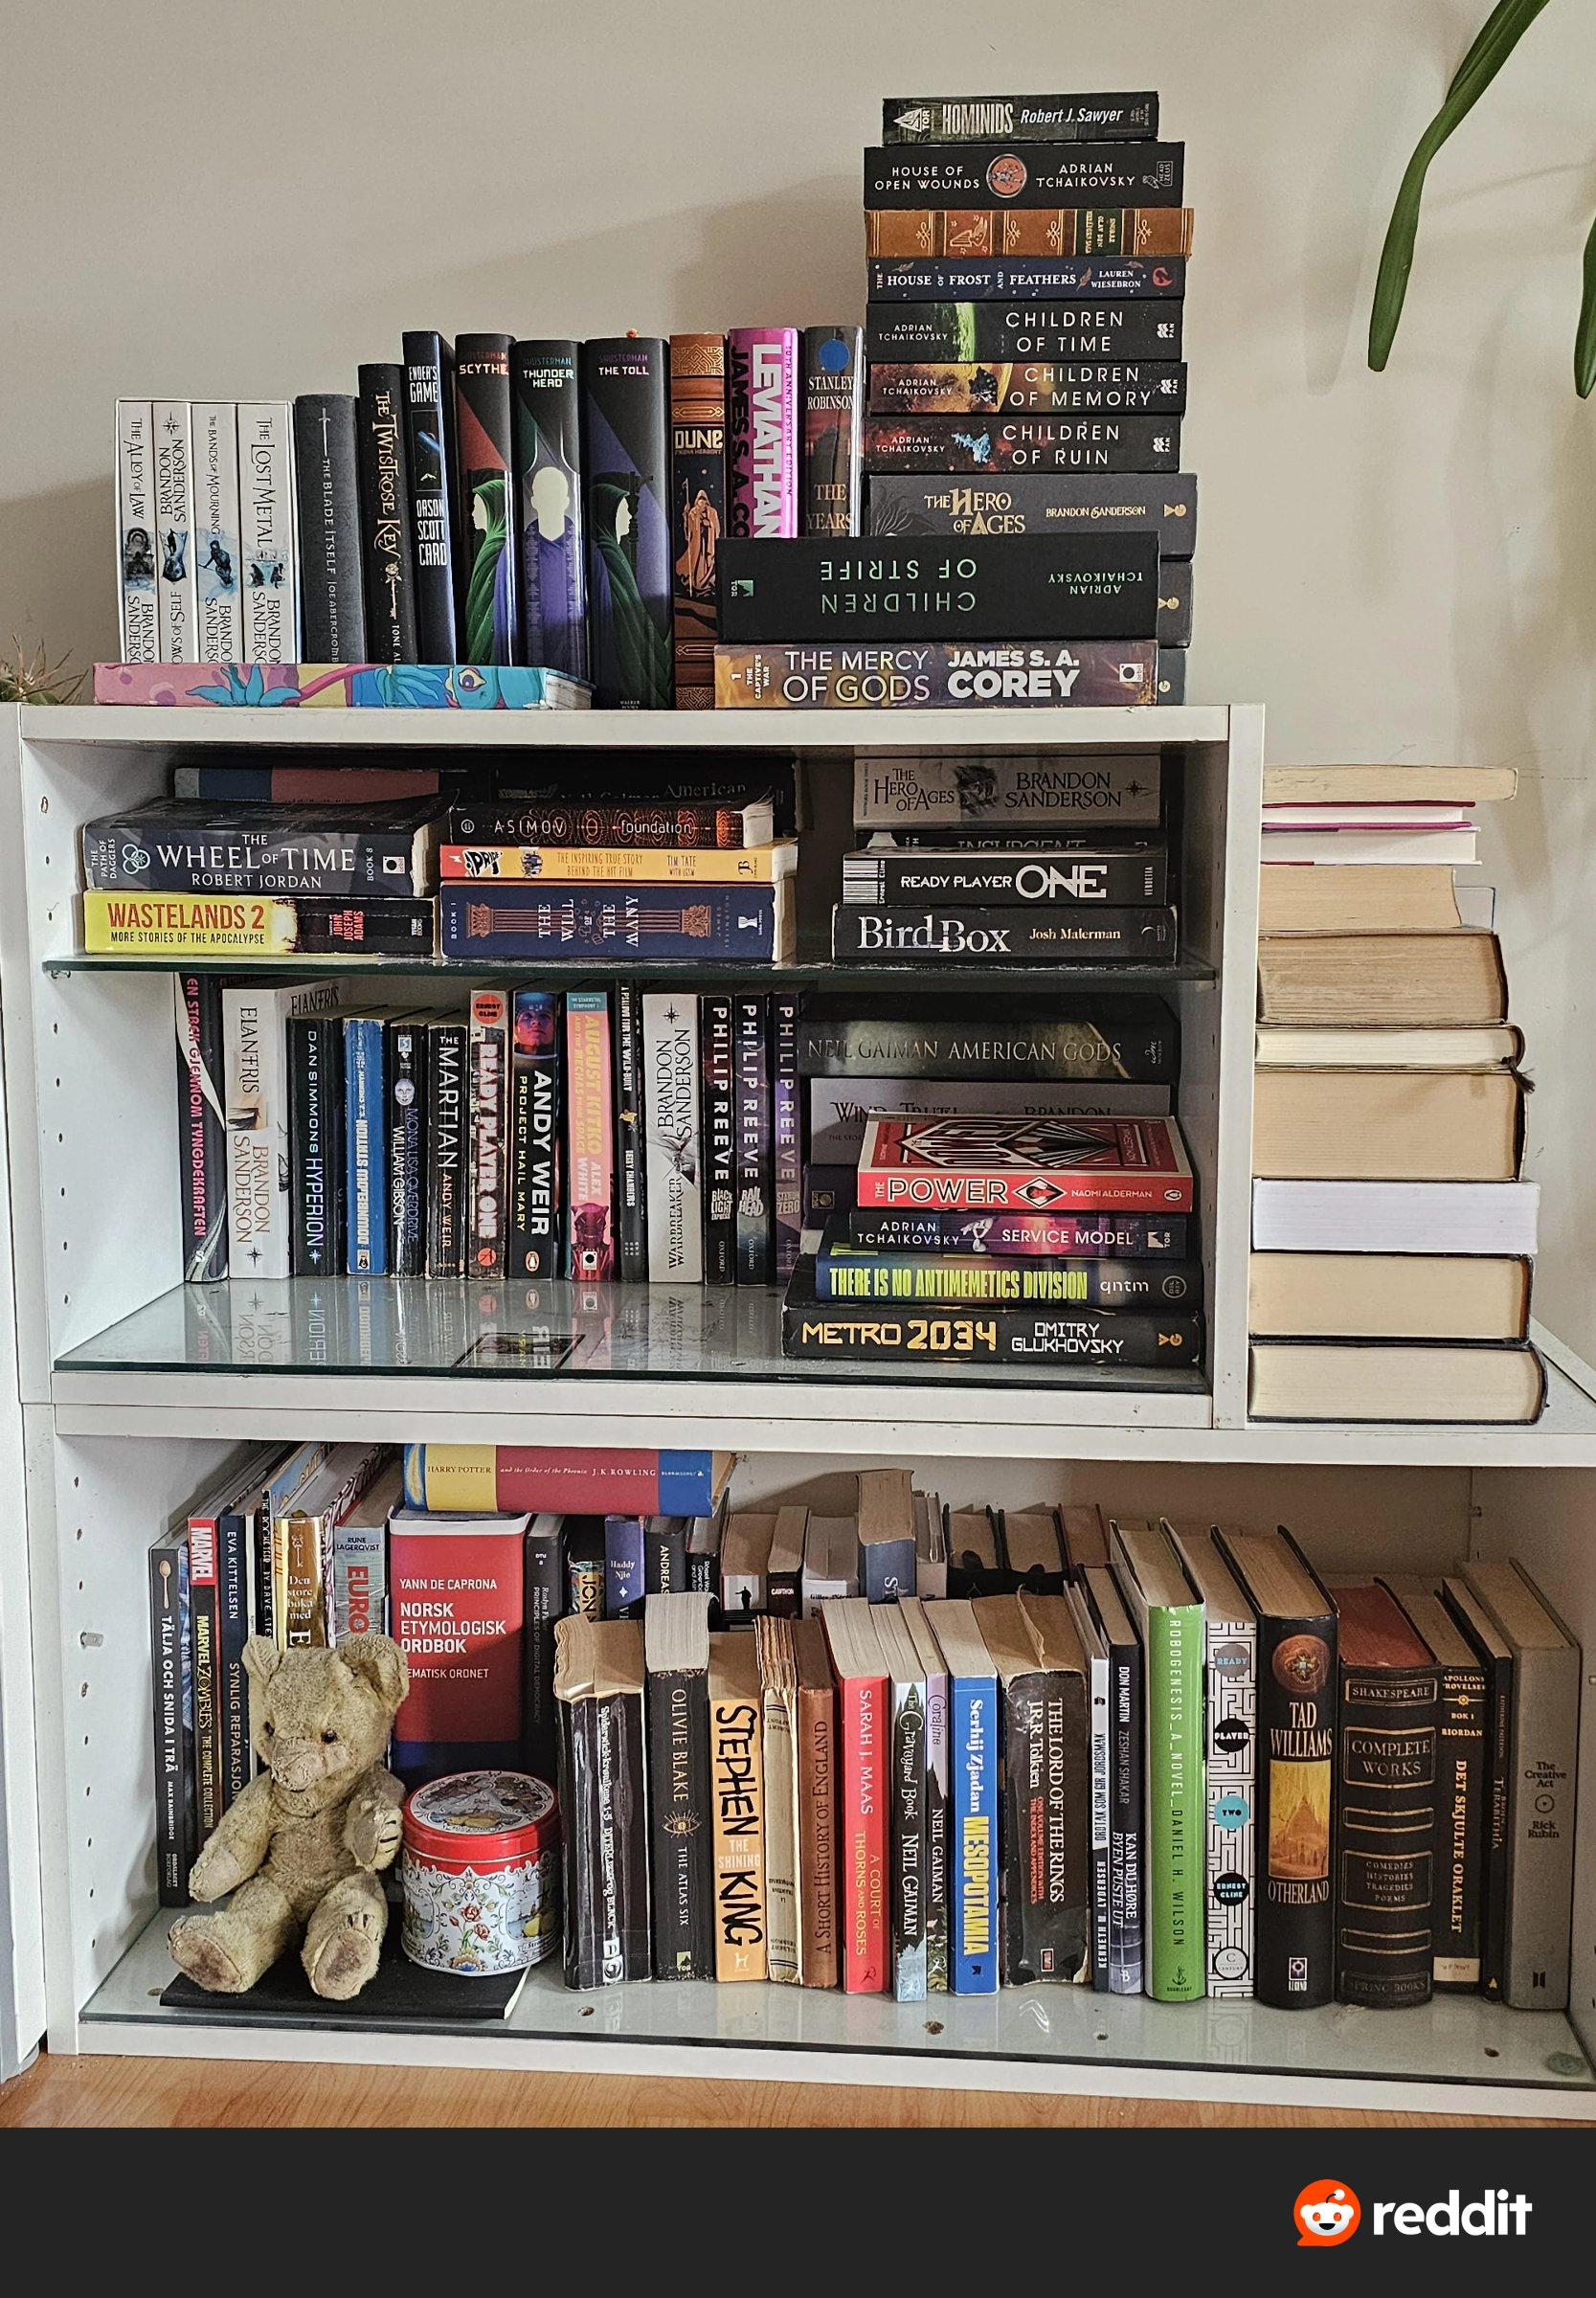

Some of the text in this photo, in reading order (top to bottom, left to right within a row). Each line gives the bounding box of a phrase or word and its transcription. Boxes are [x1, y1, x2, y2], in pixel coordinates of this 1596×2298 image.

[942, 103, 1014, 135] HOMINIDS
[1021, 108, 1074, 124] Robert J.
[892, 166, 963, 177] HOUSE OF
[1059, 163, 1113, 174] ADRIAN
[874, 178, 979, 191] OPEN WOUNDS
[1036, 175, 1135, 188] TCHAIKOVSKY
[888, 275, 932, 286] HOUSE
[949, 275, 991, 285] FROST
[1009, 274, 1076, 285] FEATHERS
[1005, 311, 1123, 327] CHILDREN
[1017, 336, 1112, 352] OF TIME
[409, 367, 438, 382] ENDER'S
[459, 363, 508, 375] SCYTHE
[523, 368, 574, 380] THUNDER
[598, 366, 649, 375] THE TOLL
[1024, 368, 1139, 382] CHILDREN
[532, 378, 563, 388] HEAD
[410, 382, 438, 403] GAME
[1010, 391, 1151, 406] OF MEMORY
[807, 395, 853, 411] ROBINSON
[675, 428, 724, 449] DUNE
[1003, 425, 1119, 440] CHILDREN
[1012, 449, 1109, 464] OF RUIN
[159, 447, 172, 515] BRANDON
[173, 439, 187, 523] SANDERSON
[814, 484, 846, 501] THE
[416, 499, 444, 517] ORSON
[806, 512, 852, 529] YEARS
[417, 521, 445, 540] SCOTT
[419, 546, 447, 566] CARD
[820, 559, 977, 580] OF STRIFE
[821, 592, 976, 613] CHILDREN
[785, 651, 929, 670] THE MERCY
[948, 649, 1079, 667] JAMES S. A.
[783, 675, 931, 701] OF GODS
[947, 670, 1080, 698] COREY
[1016, 772, 1111, 790] BRANDON
[1005, 791, 1122, 810] SANDERSON
[495, 820, 565, 834] ASIMOV
[621, 819, 692, 835] foundation
[241, 834, 267, 845] THE
[156, 845, 355, 871] WHEEL OF TIME
[191, 873, 322, 890] ROBERT JORDAN
[901, 865, 1107, 898] READY PLAYER ONE
[107, 903, 265, 929] WASTELANDS 2
[111, 932, 264, 944] MORE STORIES OF THE APOCALYPSE
[1029, 928, 1120, 941] Josh Malerman
[948, 1040, 1122, 1062] AMERICAN GODS
[712, 1006, 730, 1182] PHILIP REEVE
[438, 1047, 459, 1168] MARTIAN
[305, 1030, 324, 1247] DAN SIMMONS HYPERION
[530, 1070, 551, 1236] ANDY WEIR
[235, 1135, 252, 1243] SANDERSON
[252, 1145, 270, 1233] BRANDON
[888, 1178, 1008, 1204] POWER
[880, 1222, 936, 1232] ADRIAN
[858, 1233, 959, 1245] TCHAIKOVSKY
[1001, 1228, 1134, 1245] SERVICE MODEL
[830, 1268, 1088, 1300] THERE IS NO ANTIMEMETICS DIVISION
[1100, 1278, 1149, 1294] qntm
[802, 1319, 997, 1351] METRO 2034
[1011, 1339, 1124, 1355] GLUKHOVSKY
[191, 1526, 213, 1580] MARVEL
[400, 1579, 497, 1590] YANN DE CAPRONA
[400, 1603, 454, 1617] NORSK
[400, 1620, 506, 1635] ETYMOLOGISK
[161, 1616, 173, 1657] TÄLJA
[401, 1638, 467, 1654] ORDBOK
[1217, 1657, 1248, 1666] READY
[163, 1659, 173, 1683] OCH
[1352, 1686, 1429, 1699] SHAKESPEARE
[163, 1685, 174, 1735] SNIDA
[1289, 1701, 1316, 1728] TAD
[1442, 1728, 1483, 1737] RIORDAN
[671, 1688, 688, 1802] OLIVIE BLAKE
[860, 1689, 873, 1814] SARAH J. MAAS
[1270, 1728, 1333, 1758] WILLIAMS
[1351, 1739, 1430, 1755] COMPLETE
[165, 1747, 177, 1772] TRÄ
[962, 1699, 984, 1813] Serhij Zjadan
[715, 1705, 759, 1836] STEPHEN
[1362, 1761, 1422, 1777] WORKS
[1535, 1762, 1556, 1770] The
[1524, 1770, 1566, 1780] Creative
[1536, 1779, 1554, 1789] Act
[1527, 1829, 1560, 1838] Rubin
[1532, 1820, 1556, 1830] Rick
[729, 1839, 750, 1853] THE
[813, 1721, 831, 1954] A SHORT HISTORY OF ENGLAND
[1450, 1760, 1468, 1933] DET SKJULTE ORAKLET
[718, 1856, 761, 1869] SHINING
[677, 1847, 688, 1926] THE ATLAS SIX
[902, 1834, 919, 1936] NEIL GAIMAN
[963, 1816, 989, 1955] MESOPOTAMIA
[1269, 1881, 1329, 1904] OTHERLAND
[719, 1871, 763, 1947] KING
